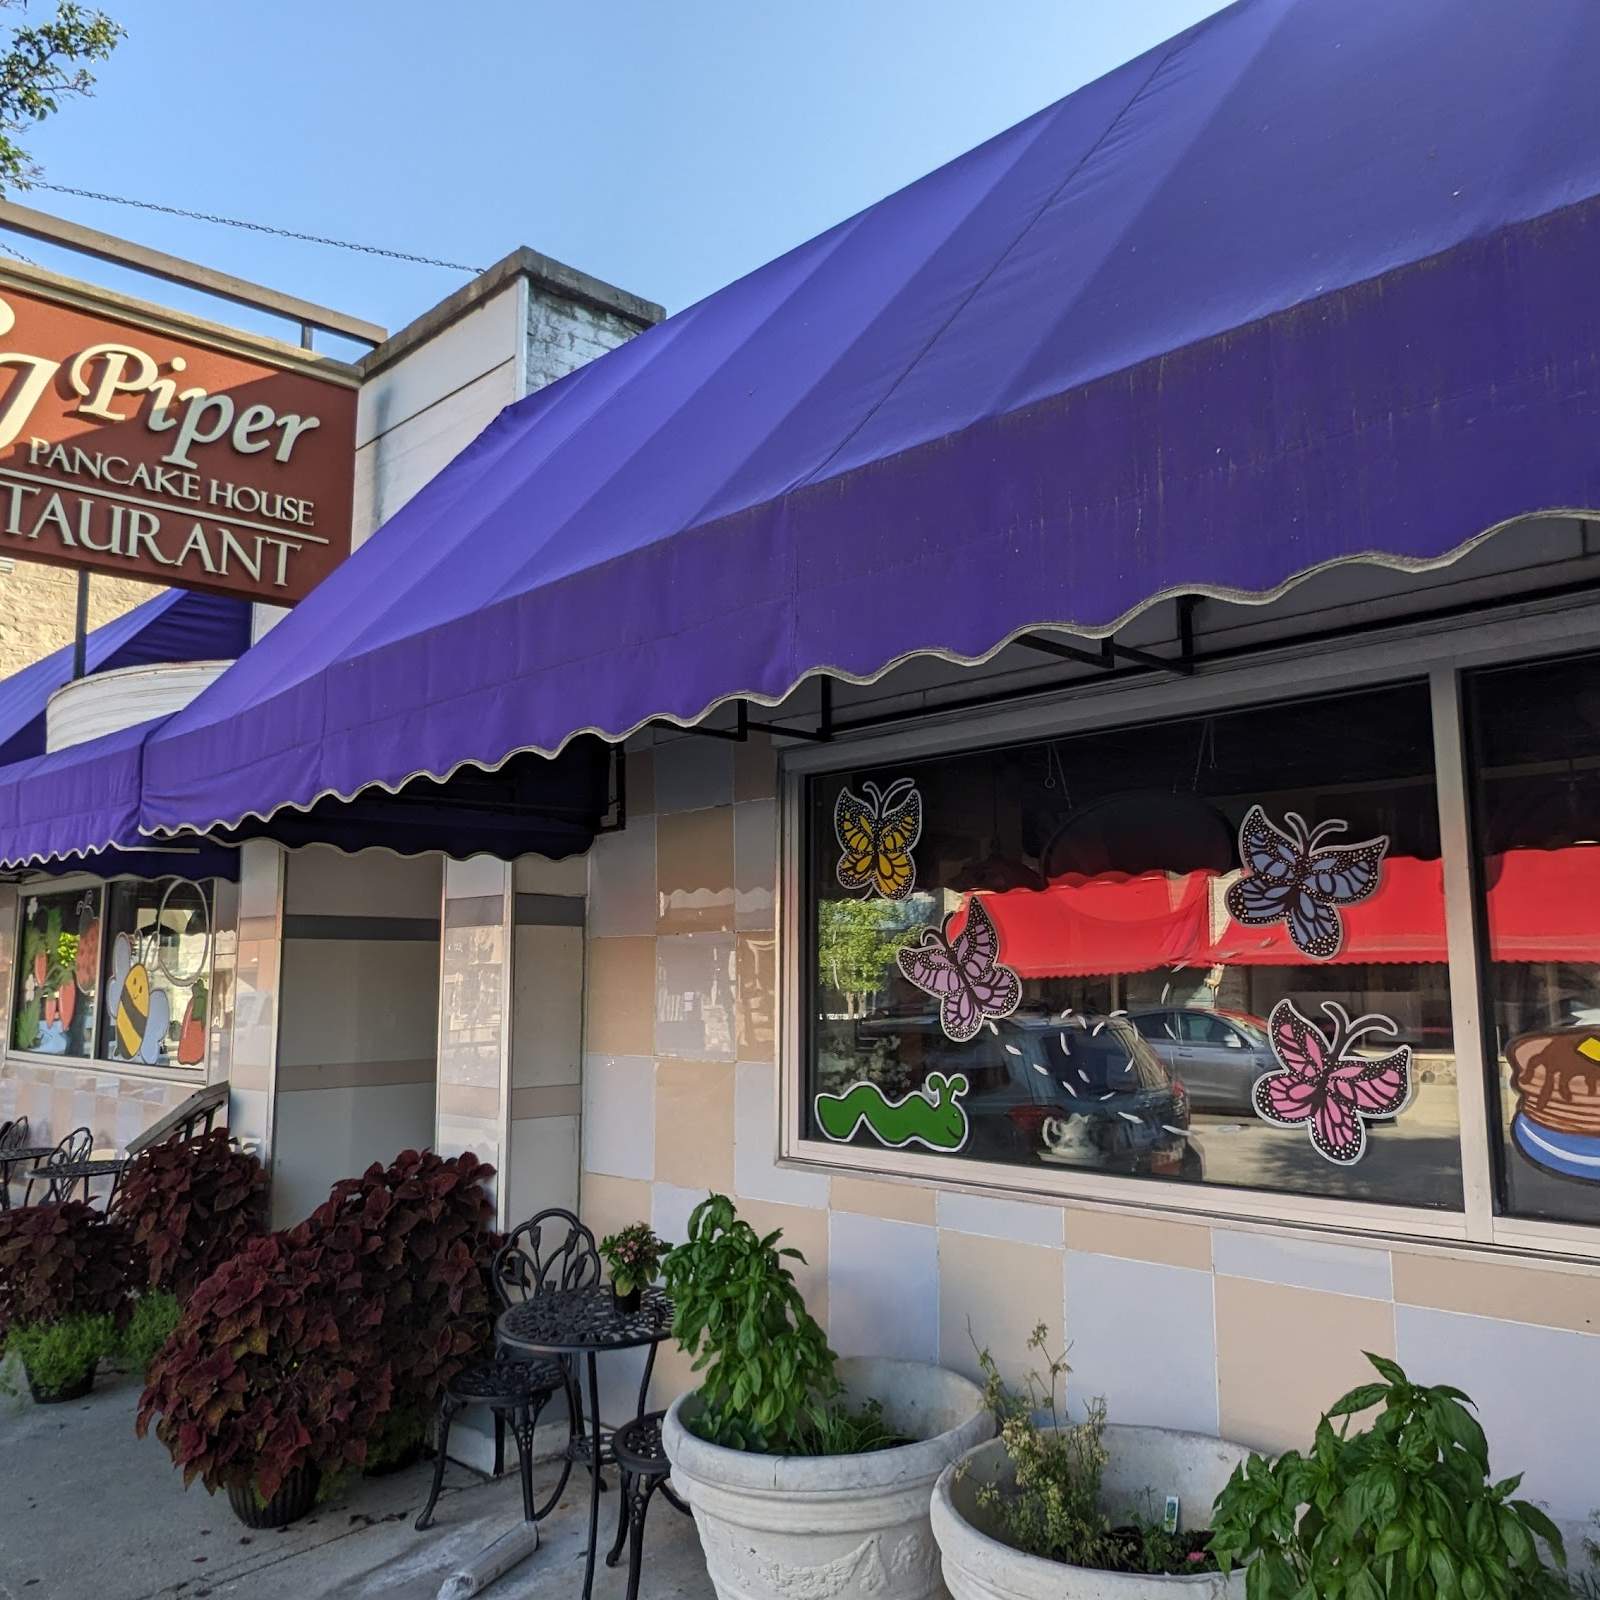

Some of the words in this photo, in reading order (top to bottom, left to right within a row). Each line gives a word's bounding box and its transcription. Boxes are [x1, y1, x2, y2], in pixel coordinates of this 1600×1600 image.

[71, 343, 320, 469] Piper
[28, 436, 201, 500] PANCAKE
[210, 479, 315, 527] HOUSE
